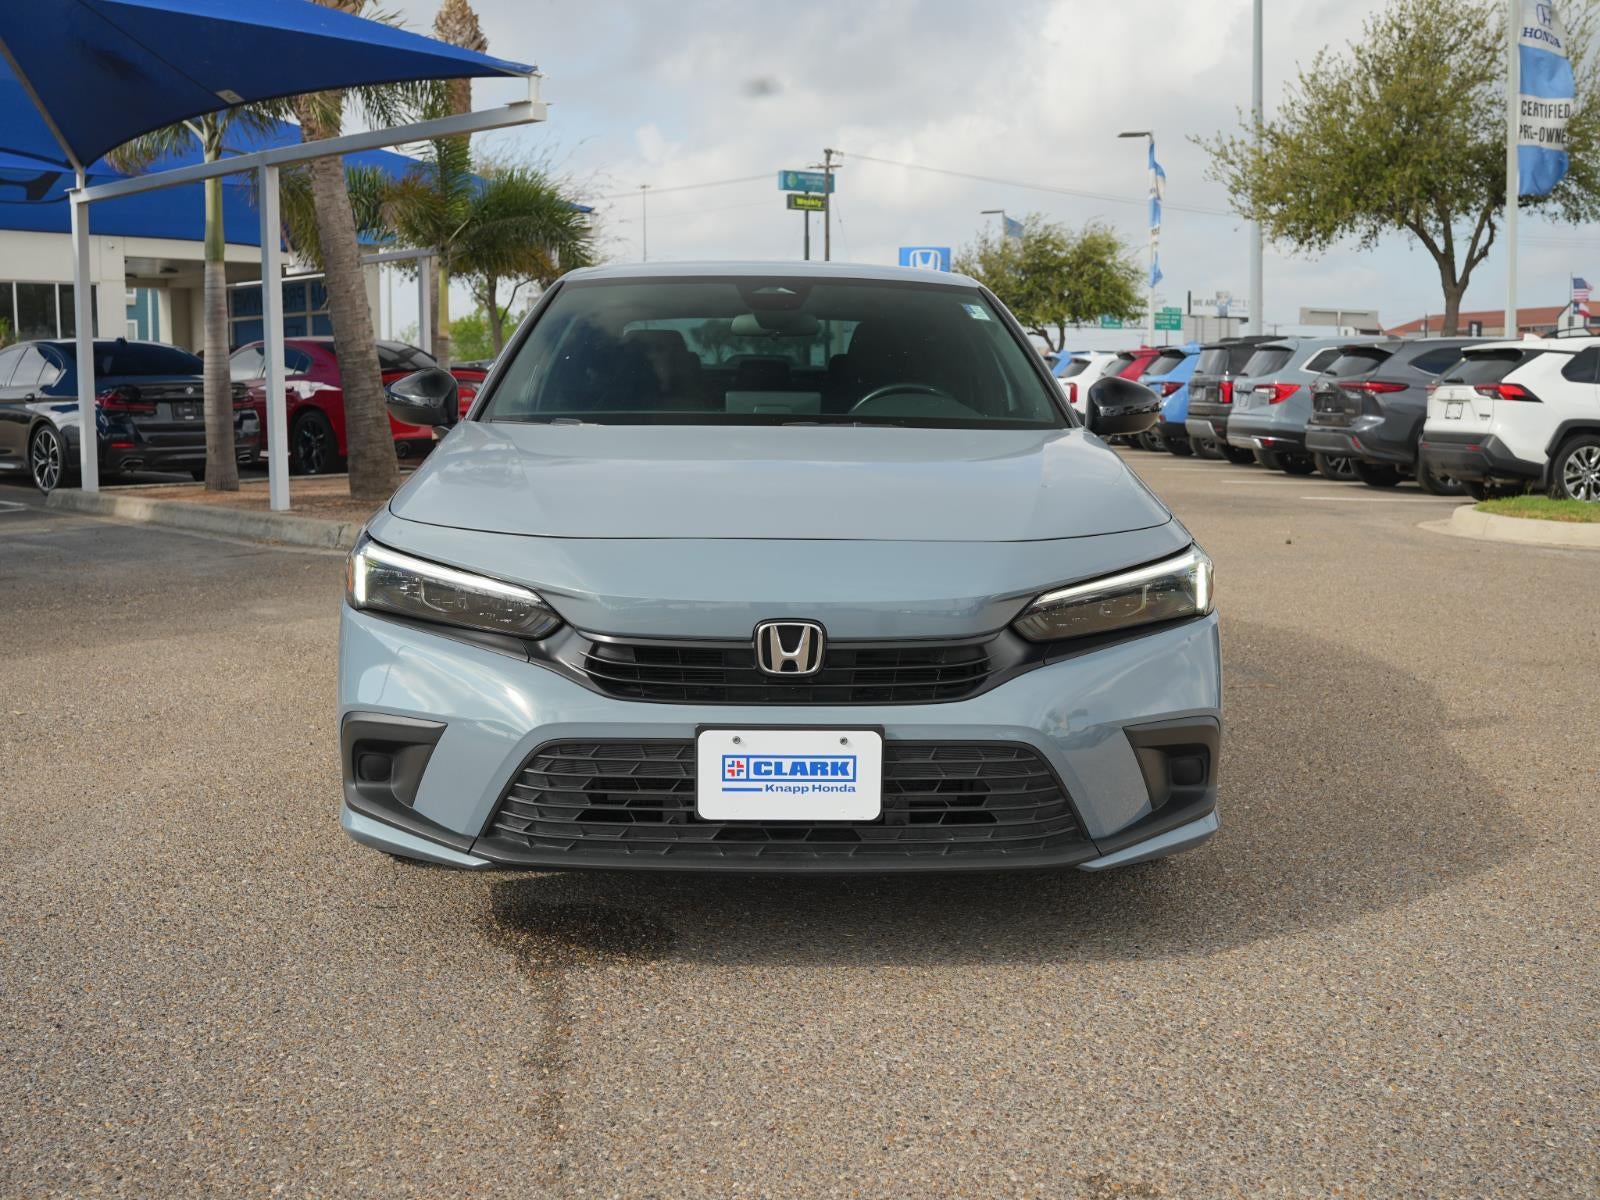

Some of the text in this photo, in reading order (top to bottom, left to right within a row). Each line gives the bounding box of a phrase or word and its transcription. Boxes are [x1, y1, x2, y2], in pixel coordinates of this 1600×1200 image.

[1521, 100, 1571, 119] CERTIFIED
[752, 760, 850, 776] CLARK
[765, 784, 856, 794] Knapp Honda
